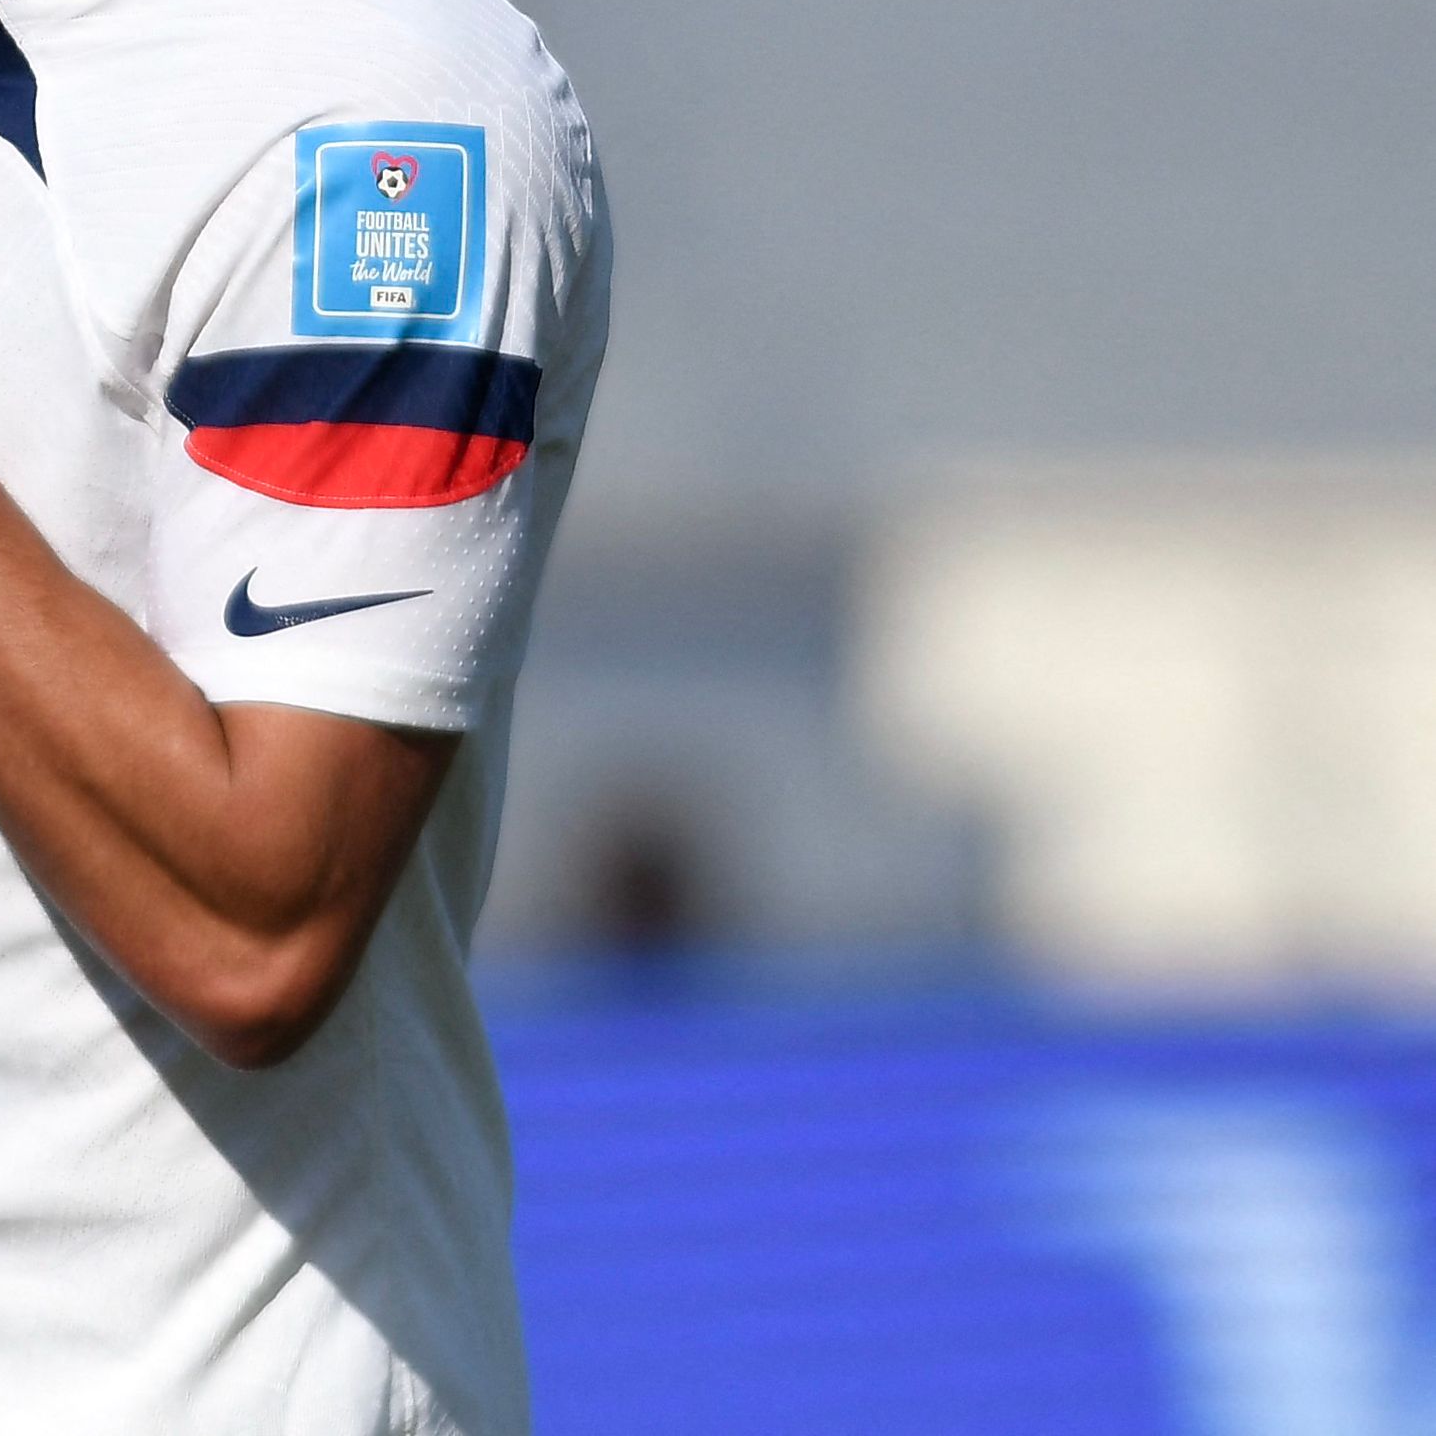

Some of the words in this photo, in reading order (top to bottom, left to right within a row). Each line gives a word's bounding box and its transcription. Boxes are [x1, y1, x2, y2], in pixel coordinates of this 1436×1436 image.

[356, 210, 430, 232] FOOTBALL
[355, 231, 430, 260] UNITES
[349, 258, 380, 282] the
[382, 259, 433, 285] World
[375, 291, 407, 303] FIFA
